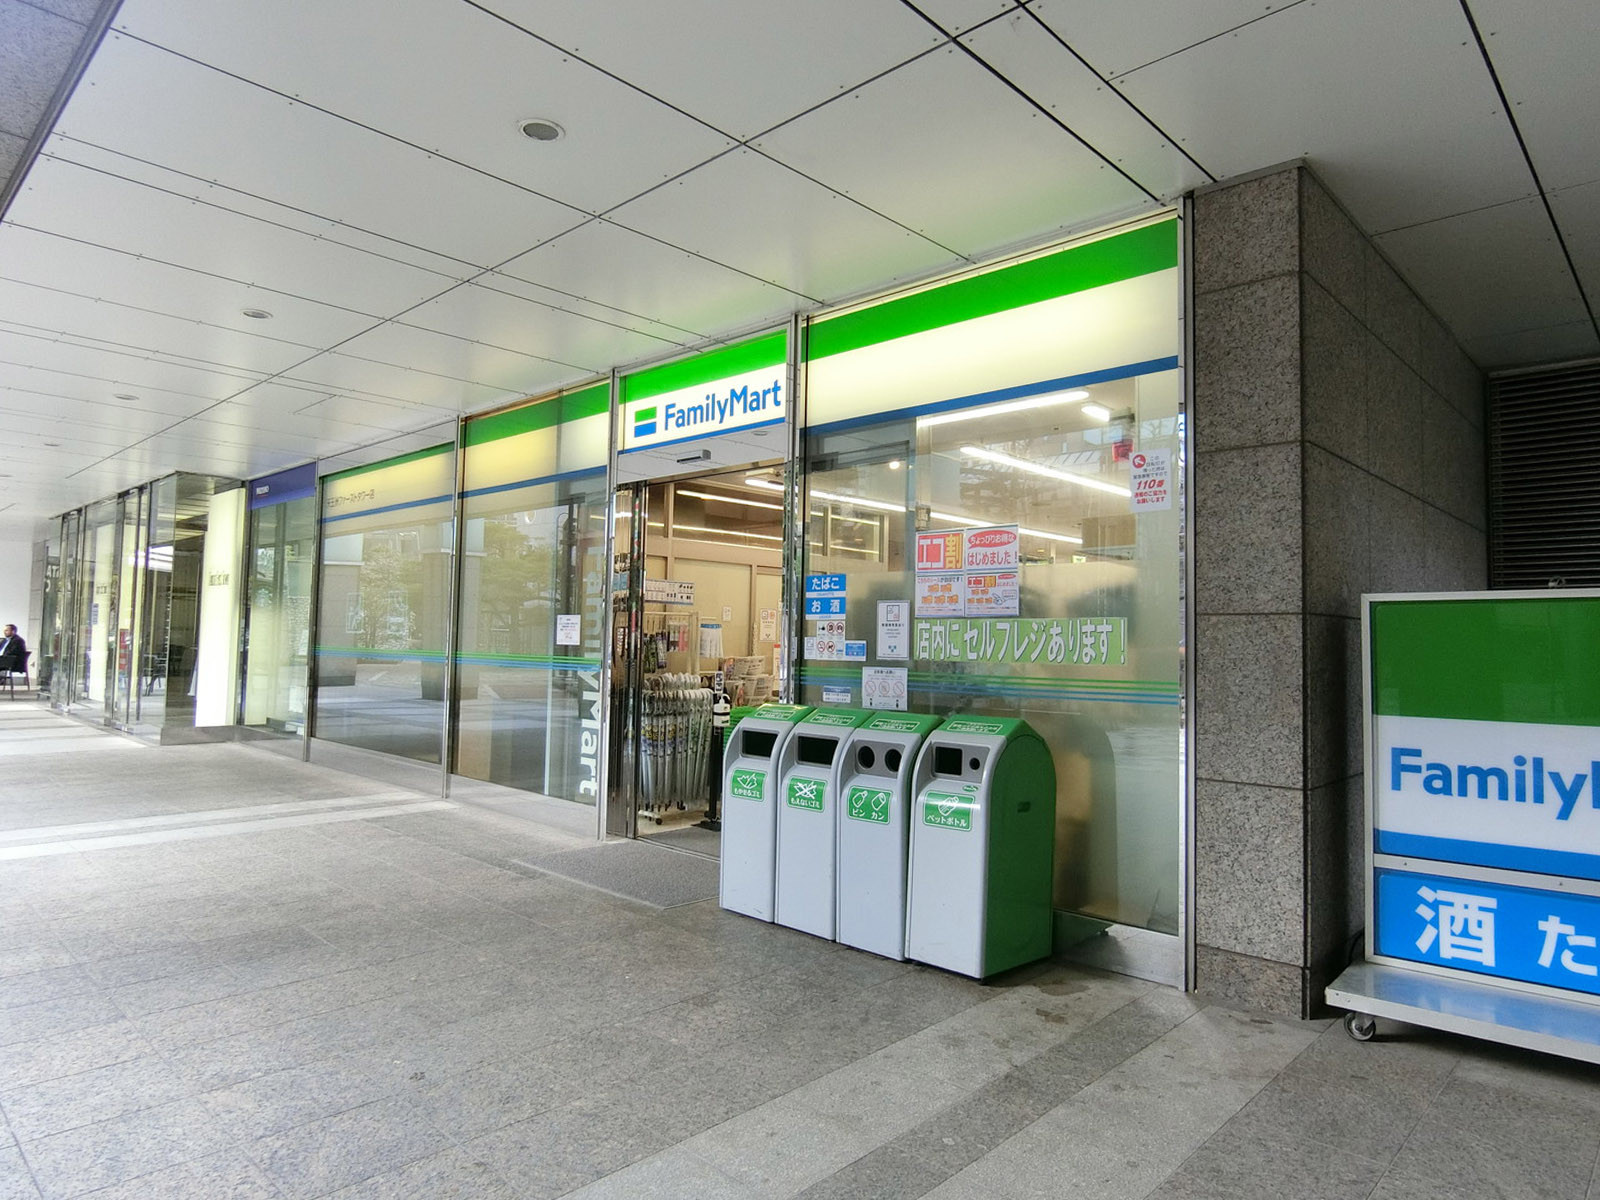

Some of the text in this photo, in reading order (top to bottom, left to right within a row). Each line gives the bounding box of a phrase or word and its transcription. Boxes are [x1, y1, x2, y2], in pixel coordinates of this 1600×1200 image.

[665, 379, 781, 431] FamilyMart
[1137, 479, 1165, 490] 110番
[918, 533, 963, 569] エコ割
[812, 577, 840, 590] たばこ
[916, 619, 1126, 665] 店内にセルフレジあります！
[1391, 746, 1600, 821] Family
[790, 797, 820, 809] もえないゴミ
[871, 812, 885, 821] カン
[926, 814, 968, 828] ペットボトル
[1415, 885, 1498, 968] 酒
